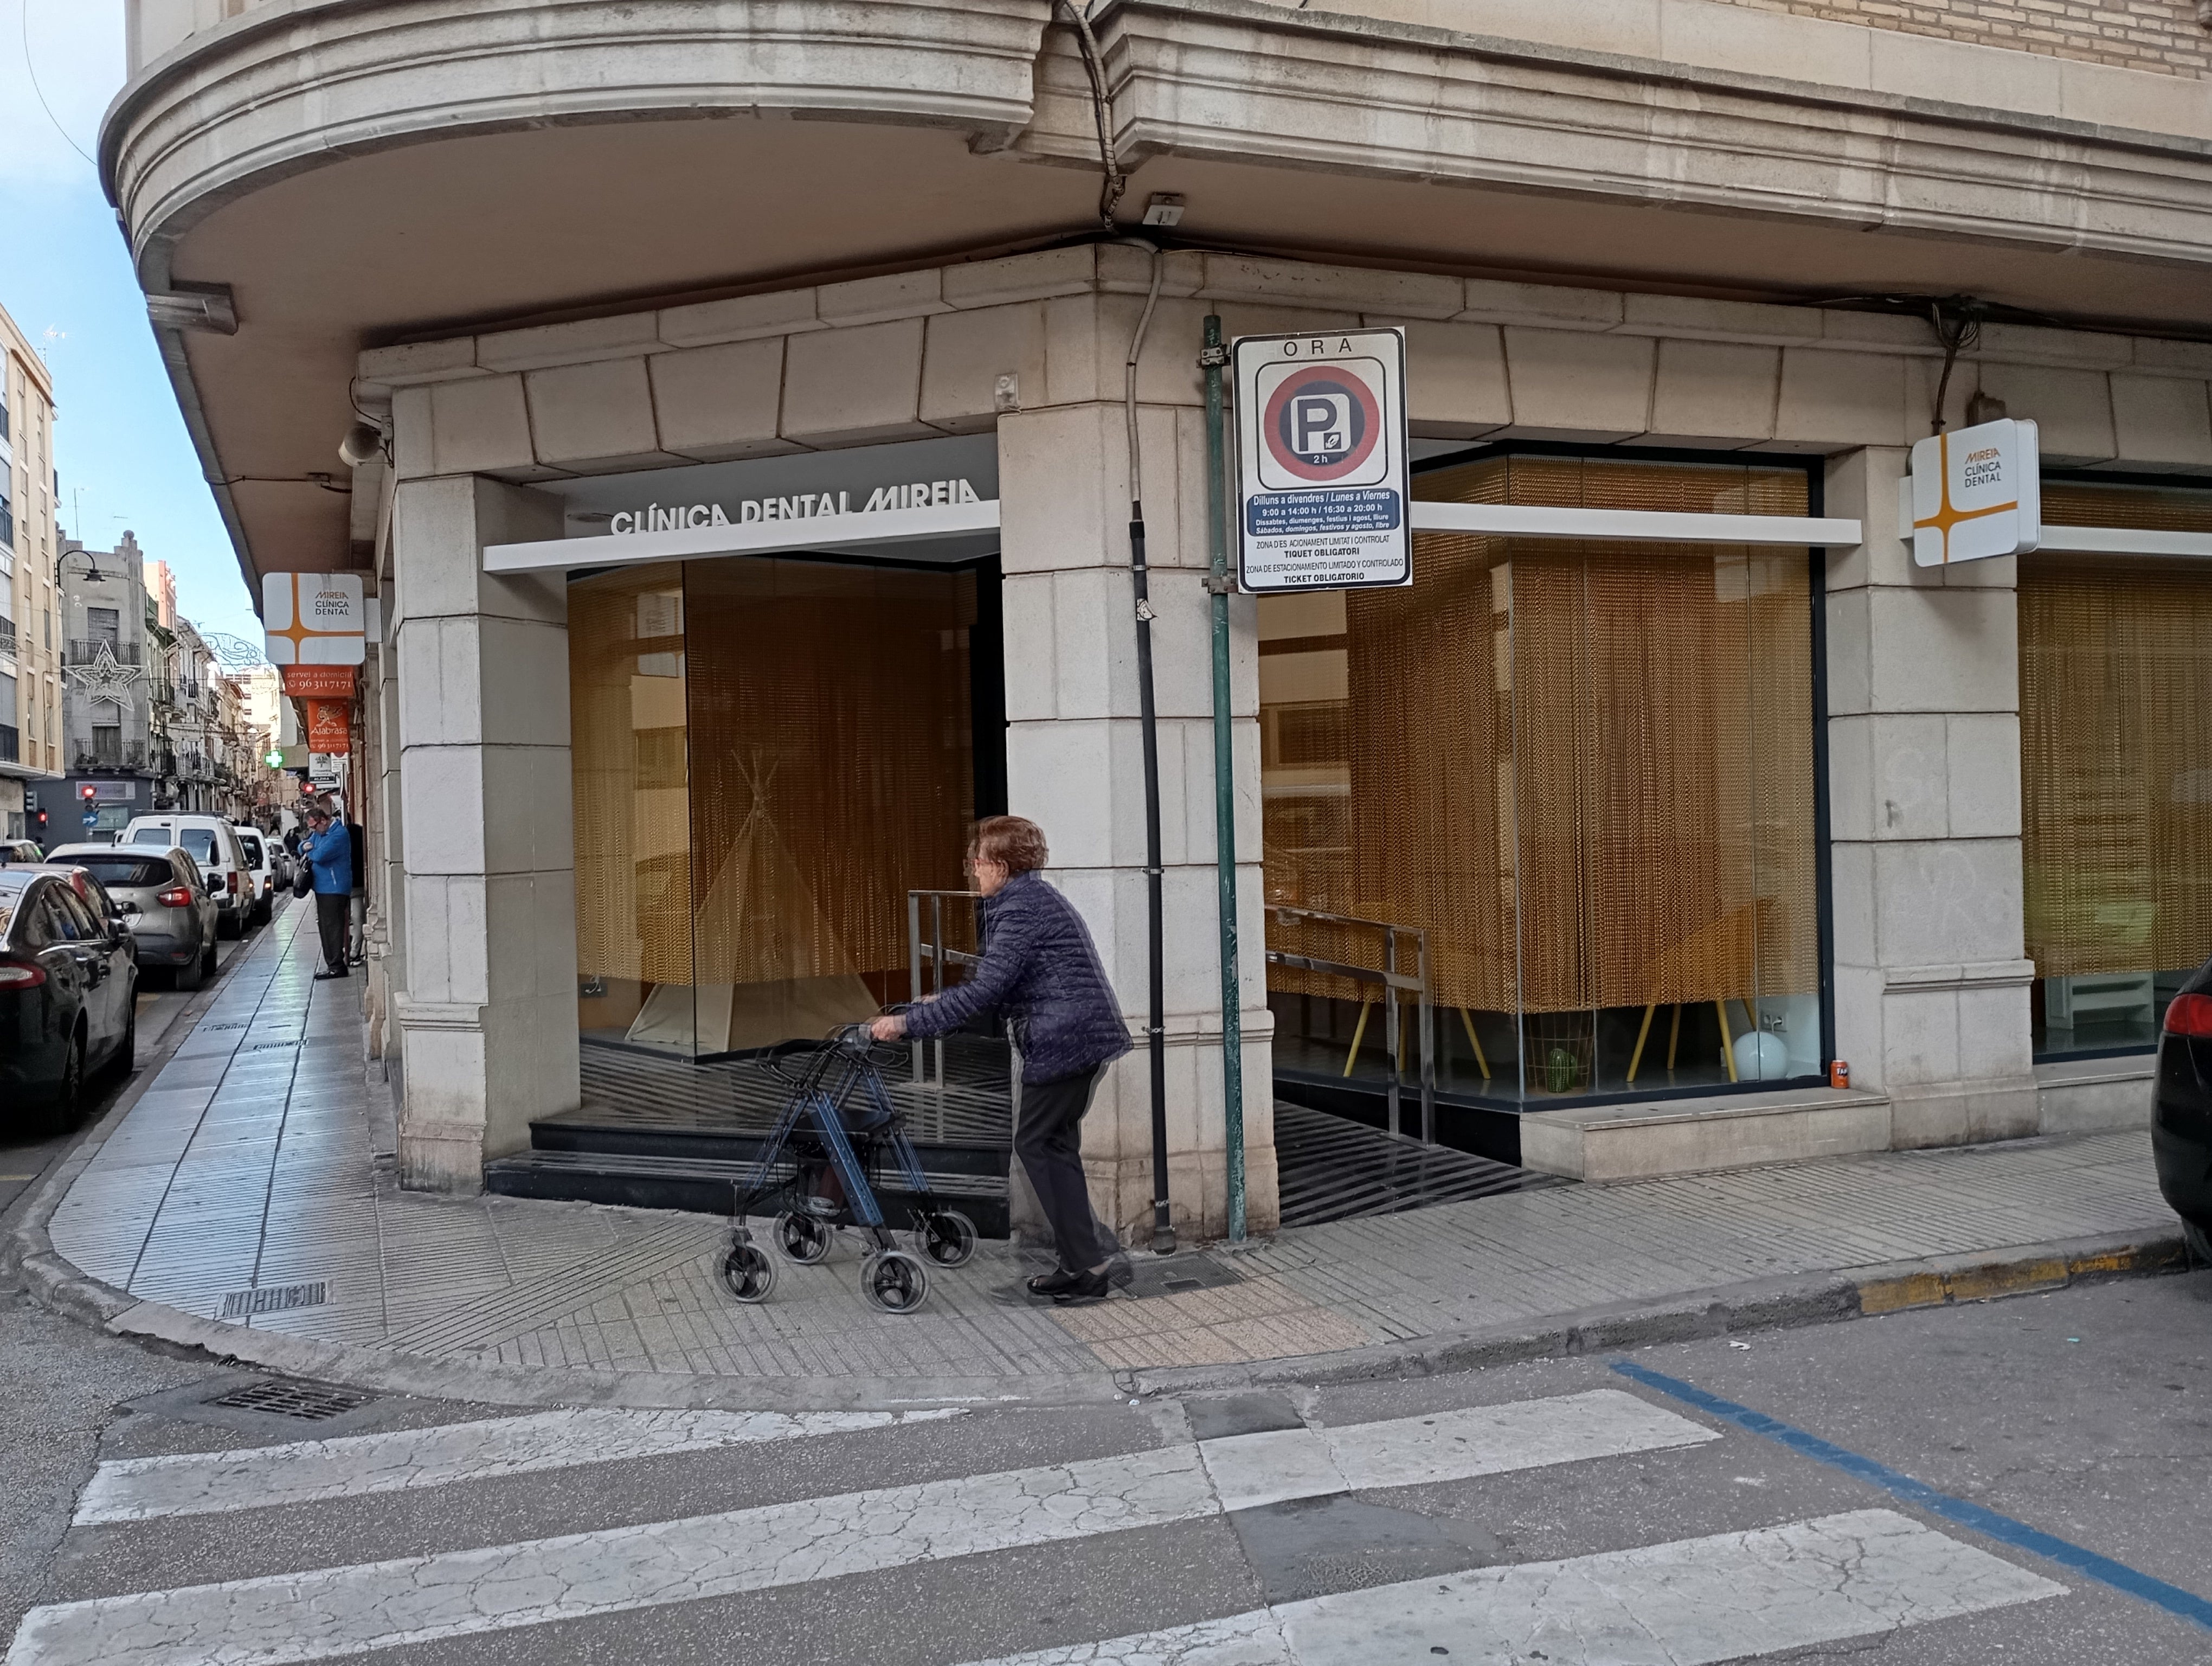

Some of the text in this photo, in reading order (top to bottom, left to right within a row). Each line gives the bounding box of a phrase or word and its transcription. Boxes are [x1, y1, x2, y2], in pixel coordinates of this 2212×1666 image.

[1284, 338, 1352, 356] ORA
[1297, 399, 1337, 452] P
[1314, 454, 1328, 463] 2 h
[1965, 447, 2001, 464] MIREIA
[1965, 461, 2001, 476] CLÍNICA
[1965, 472, 2001, 488] DENTAL
[1253, 495, 1279, 505] Dilluns
[1287, 494, 1324, 504] divendres
[1330, 492, 1354, 502] Lunes
[1363, 491, 1390, 500] Viernes
[611, 479, 980, 535] CLÍNICA DENTAL MIREIA
[1262, 508, 1279, 516] 9:00
[1288, 507, 1309, 515] 14:00
[1323, 505, 1345, 514] 16:30
[1354, 504, 1375, 512] 20:00
[1329, 537, 1350, 545] LIMITAT
[1354, 535, 1390, 544] CONTROLAT
[1284, 547, 1359, 558] TIQUET OBLIGATORI
[1264, 565, 1272, 573] DE
[1273, 562, 1327, 572] ESTACIONAMIENTO
[1329, 561, 1355, 569] LIMITADO
[1362, 558, 1403, 567] CONTROLADO
[1284, 572, 1364, 583] TICKET OBLIGATORIO
[315, 599, 349, 607] CLÍNICA
[299, 679, 312, 689] 96
